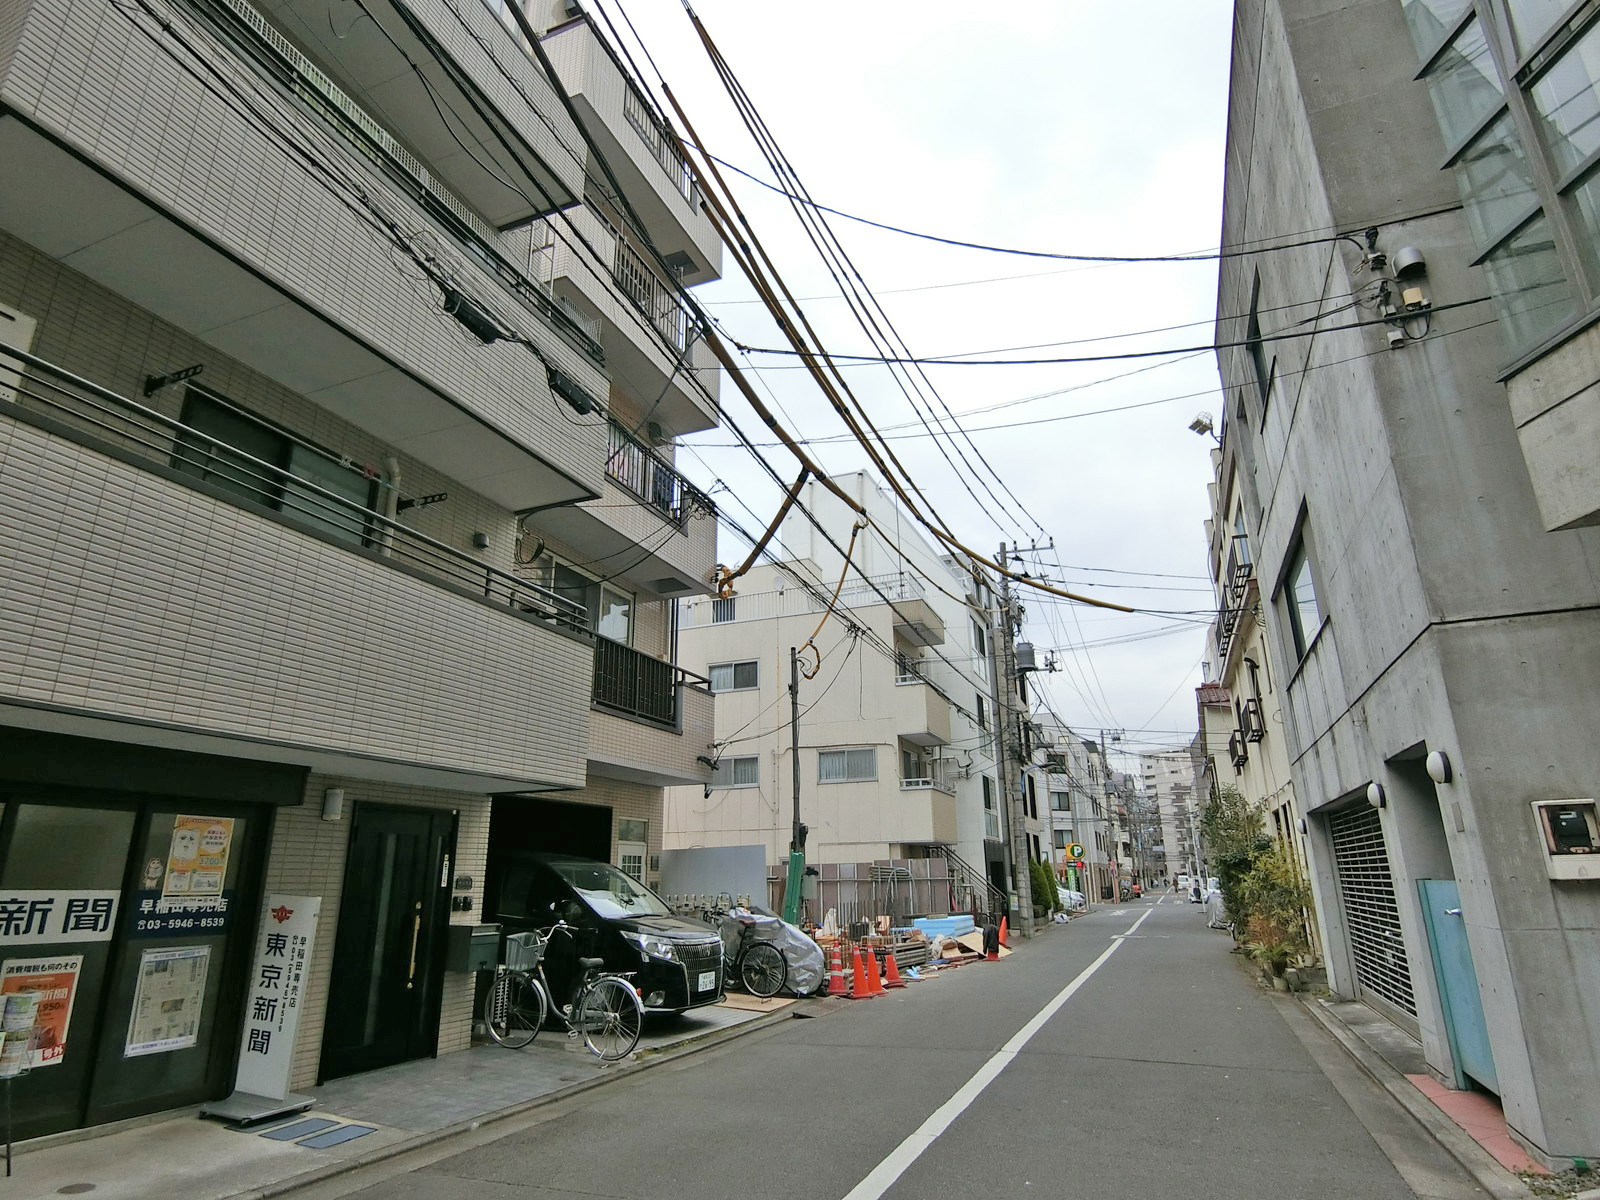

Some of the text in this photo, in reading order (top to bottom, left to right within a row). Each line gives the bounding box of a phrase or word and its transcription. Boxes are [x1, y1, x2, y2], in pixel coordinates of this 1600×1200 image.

[1074, 846, 1082, 857] P
[0, 898, 114, 936] 新聞
[147, 917, 225, 930] 03-5946-8539
[288, 936, 307, 1008] 早稲田専売店
[247, 933, 289, 1055] 東京新聞
